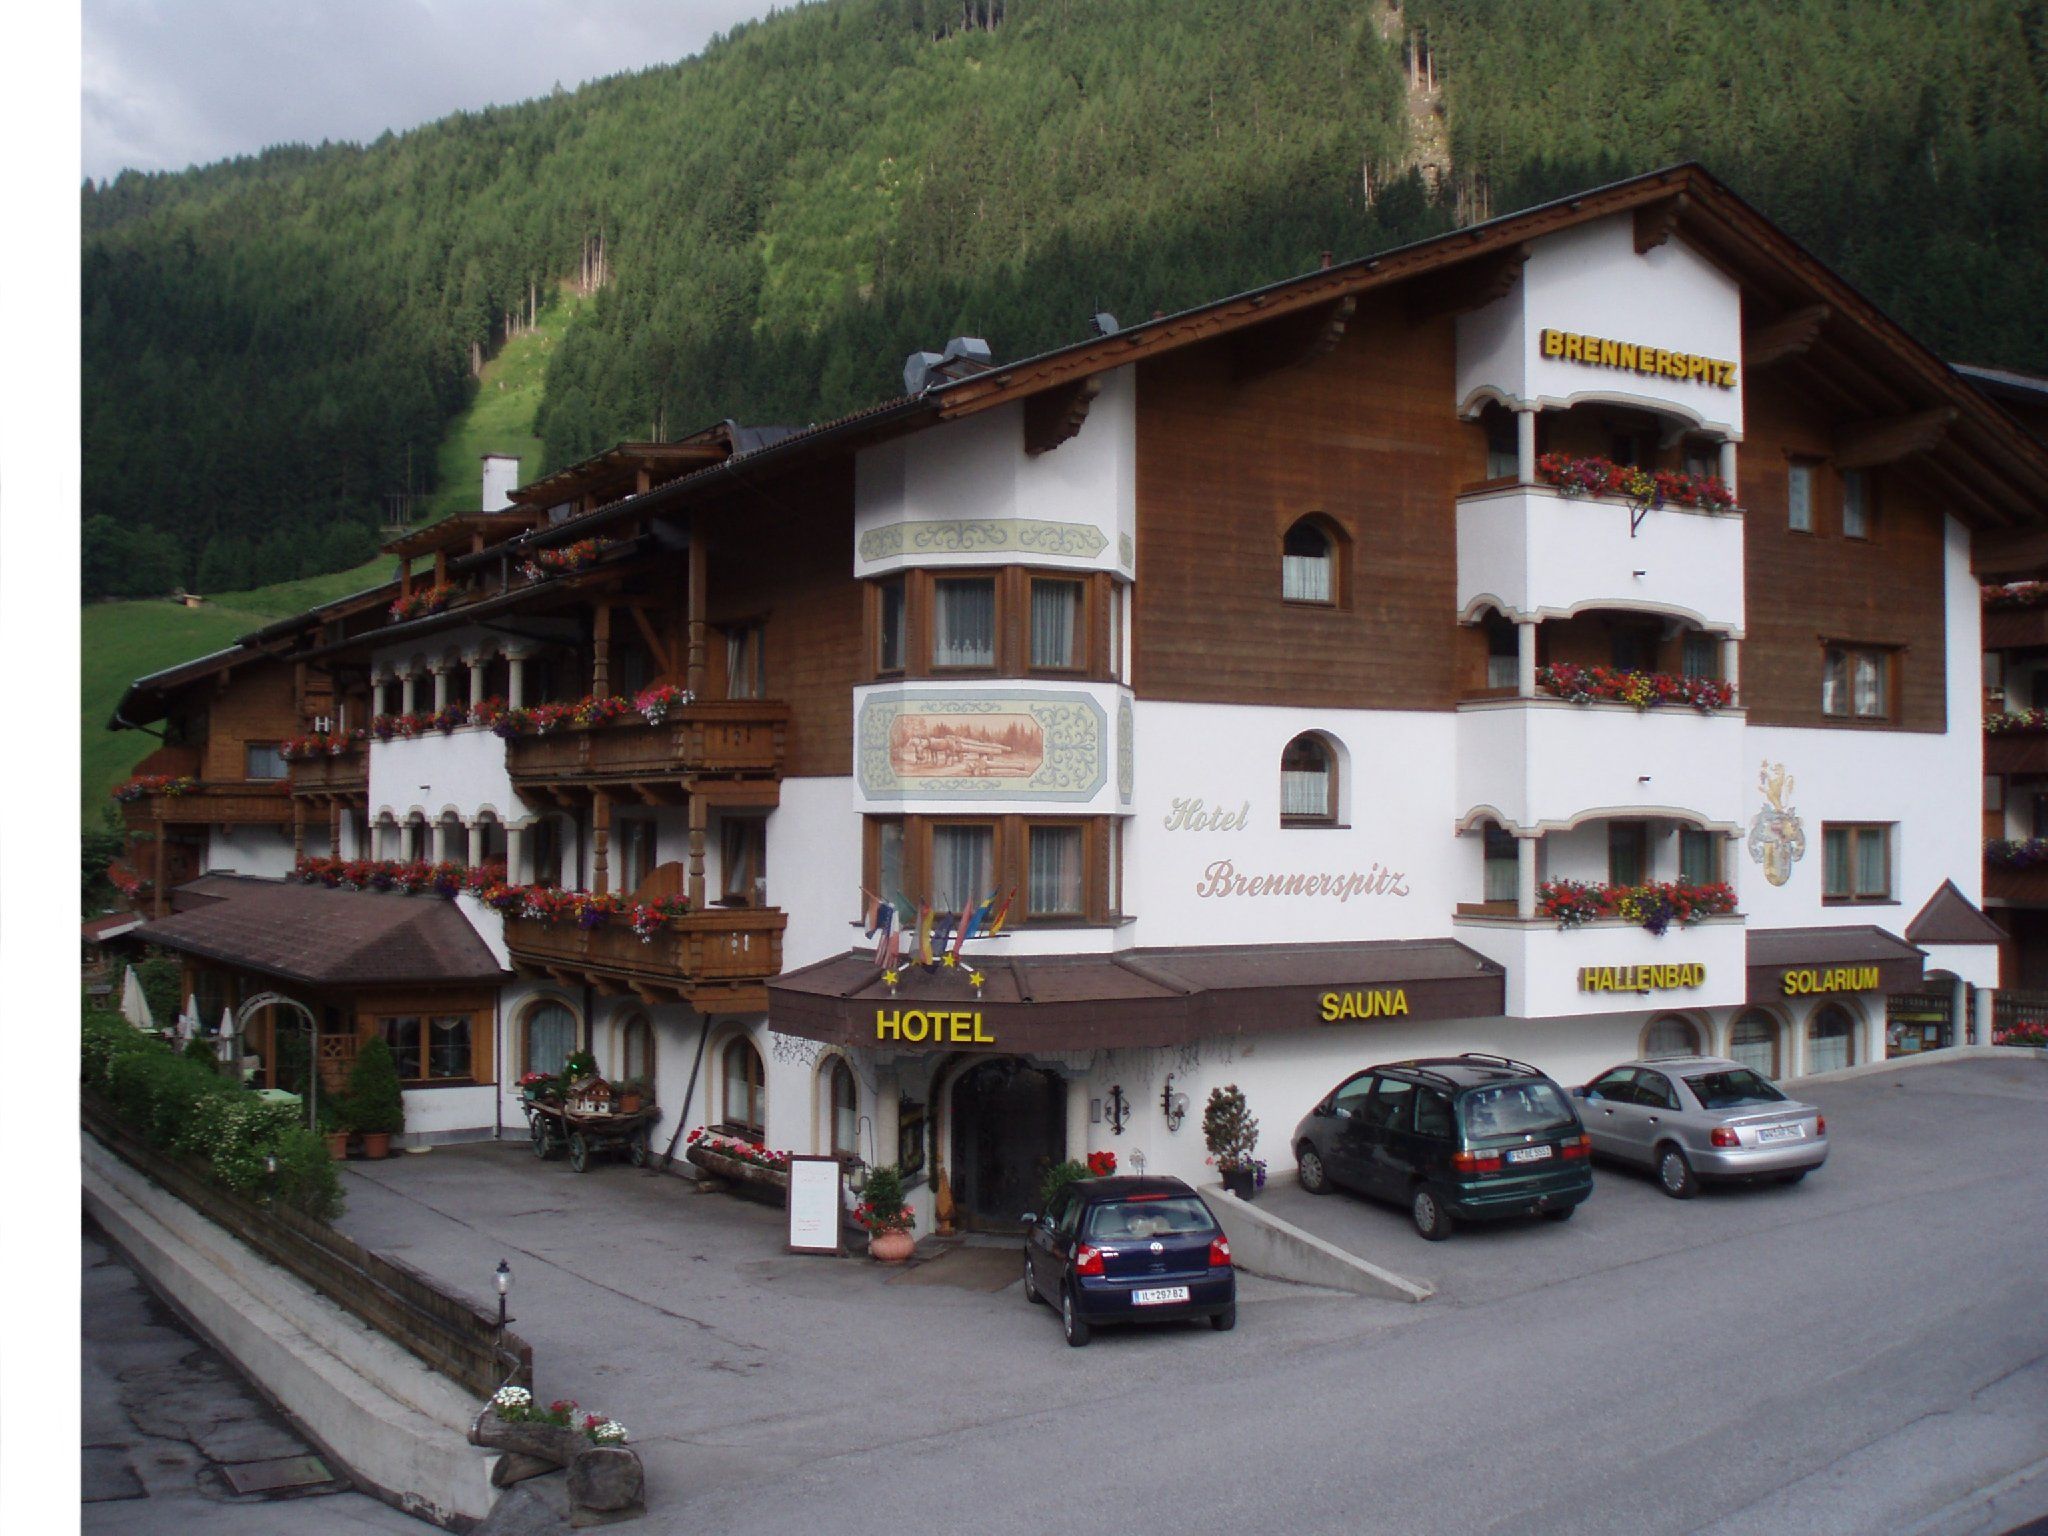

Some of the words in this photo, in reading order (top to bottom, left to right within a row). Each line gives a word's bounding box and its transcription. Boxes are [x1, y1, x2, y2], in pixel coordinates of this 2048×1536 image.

[1541, 328, 1737, 387] BRENNERSPITZ
[1164, 797, 1250, 831] Hotel
[1196, 859, 1410, 902] Brennerspitz
[1581, 963, 1706, 992] HALLENBAD
[1783, 967, 1880, 996] SOLARIUM
[1321, 989, 1408, 1021] SAUNA
[876, 1010, 995, 1043] HOTEL
